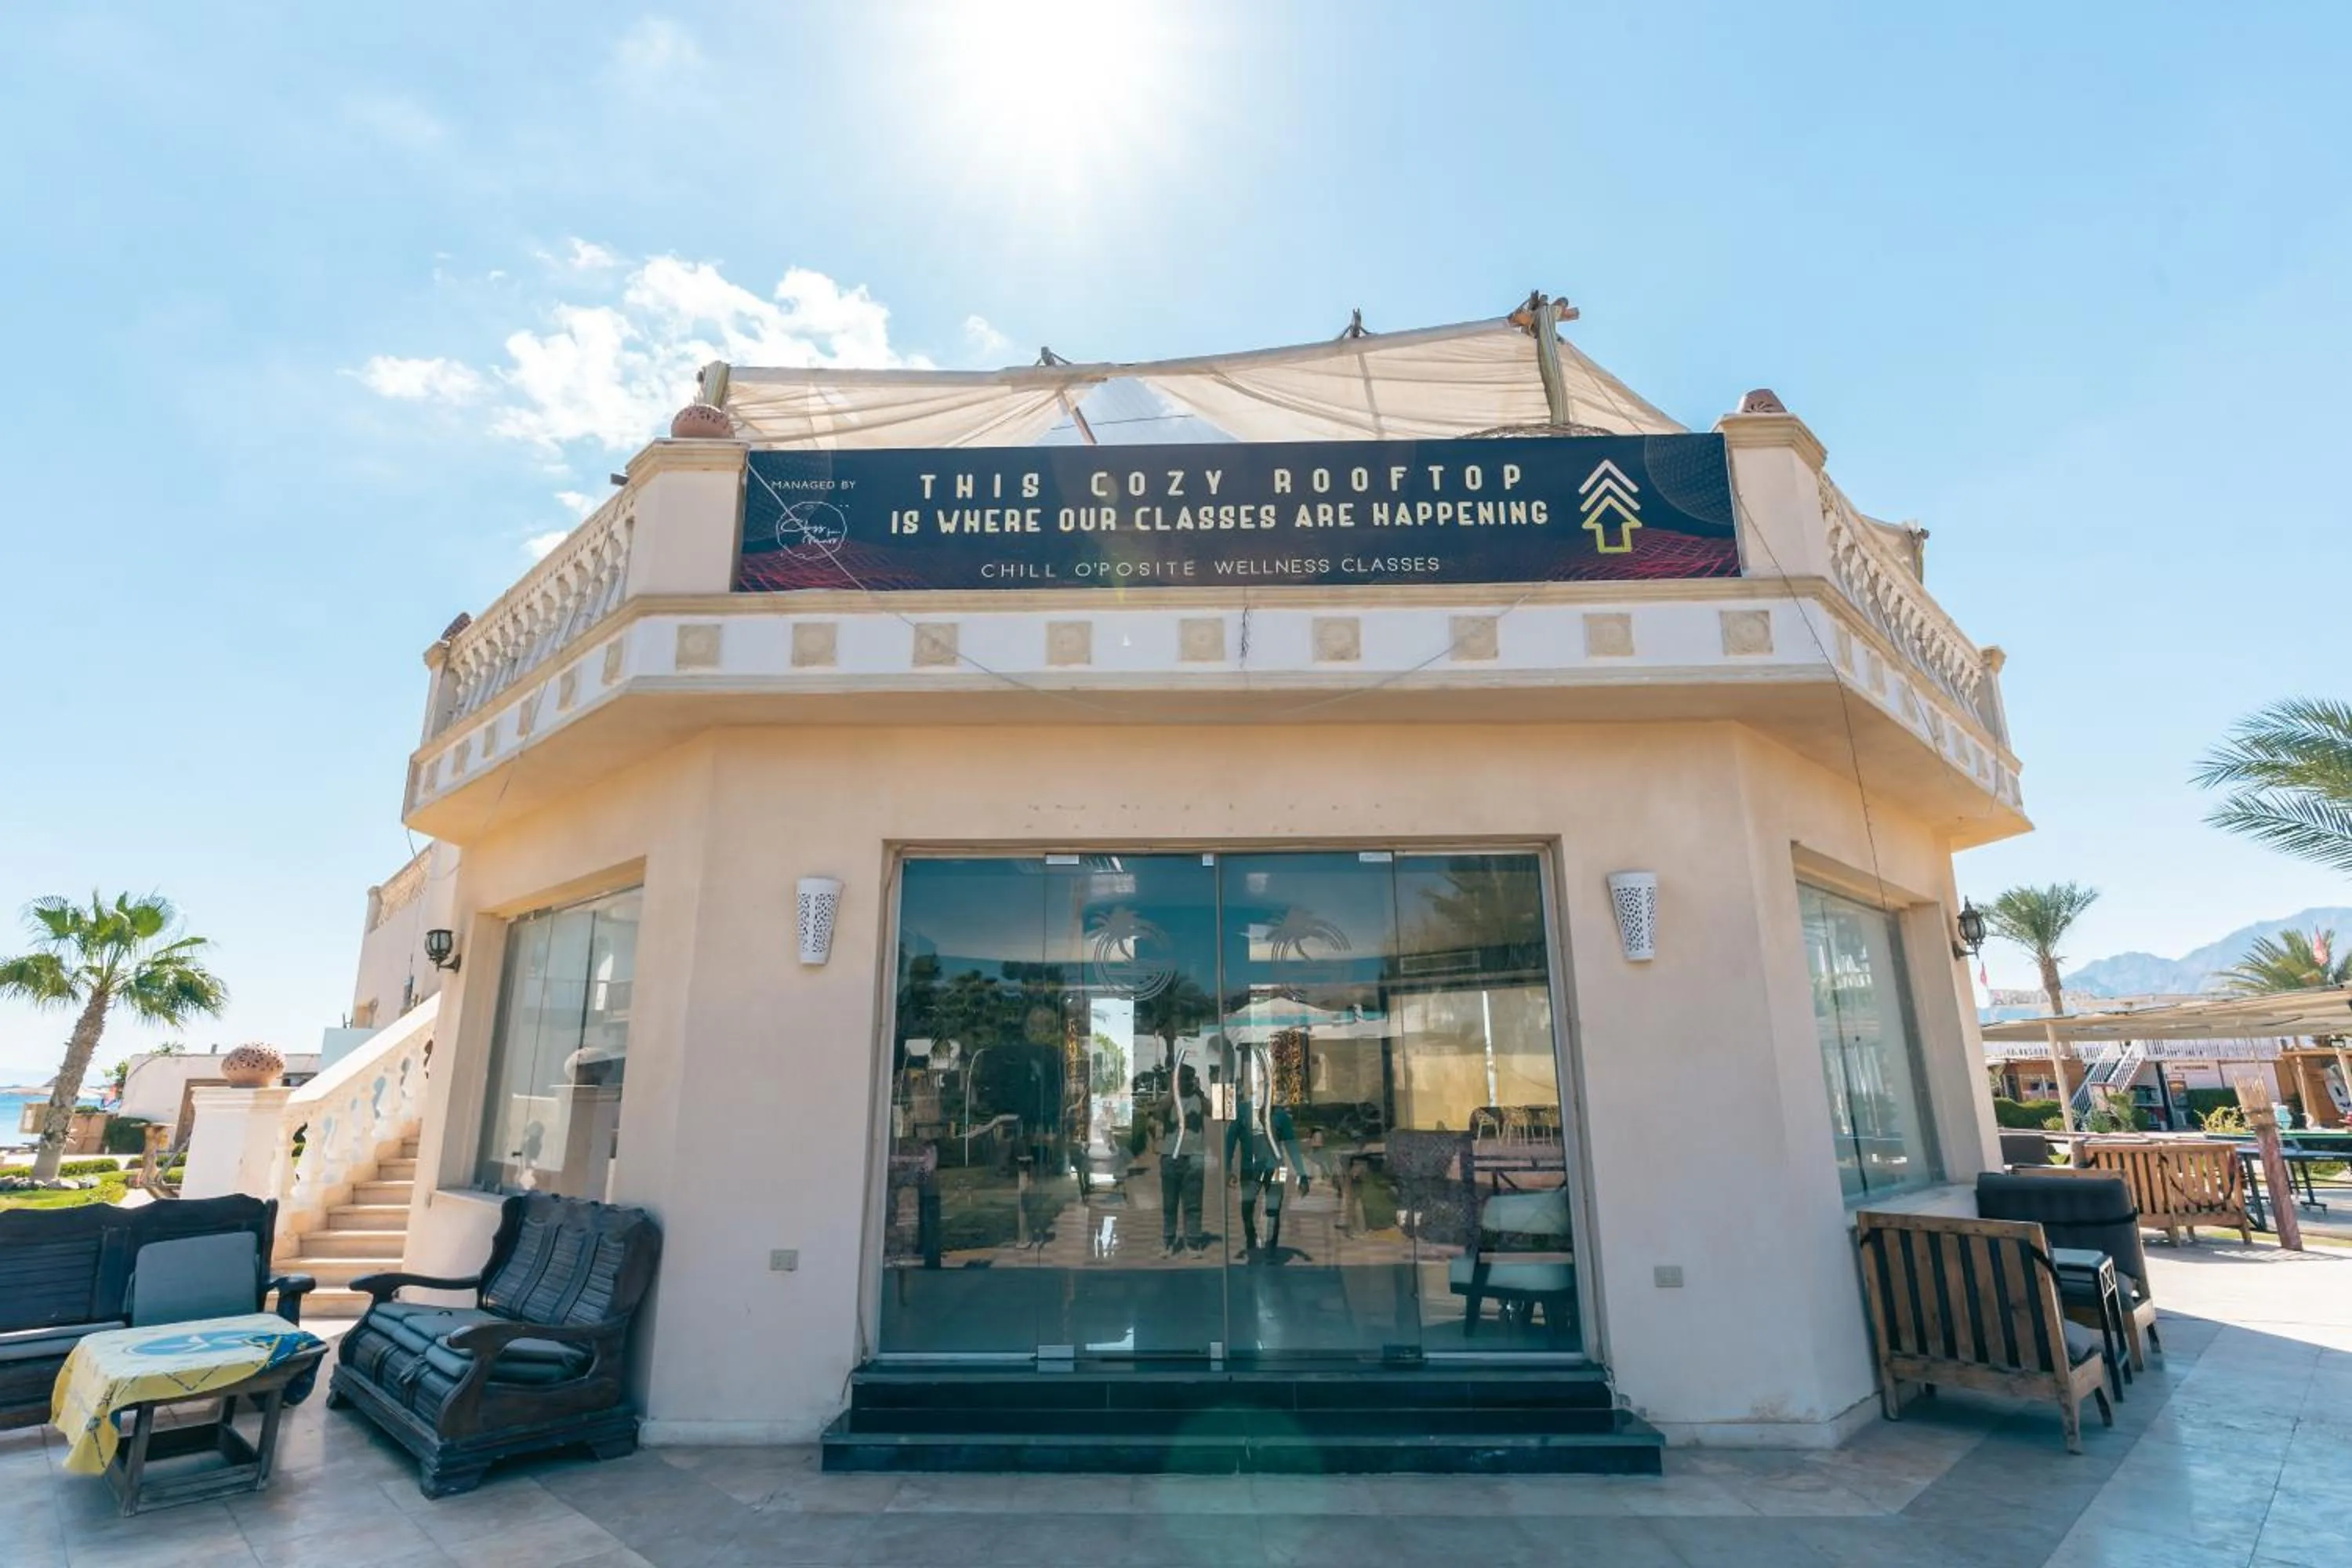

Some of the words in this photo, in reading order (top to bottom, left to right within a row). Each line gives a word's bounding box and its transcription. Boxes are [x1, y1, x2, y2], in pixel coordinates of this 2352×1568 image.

[771, 481, 835, 490] MANAGED
[841, 480, 856, 490] BY
[920, 473, 1040, 499] THIS
[1091, 470, 1222, 497] COZY
[1274, 464, 1521, 493] ROOFTOP
[891, 510, 919, 534] IS
[937, 508, 1041, 533] WHERE
[1058, 506, 1116, 532] OUR
[1134, 504, 1276, 531] CLASSES
[1294, 503, 1356, 528] ARE
[1372, 500, 1548, 526] HAPPENING
[981, 563, 1056, 578] CHILL
[1075, 561, 1196, 577] O'POSITE
[1214, 558, 1330, 575] WELLNESS
[1341, 557, 1440, 572] CLASSES
